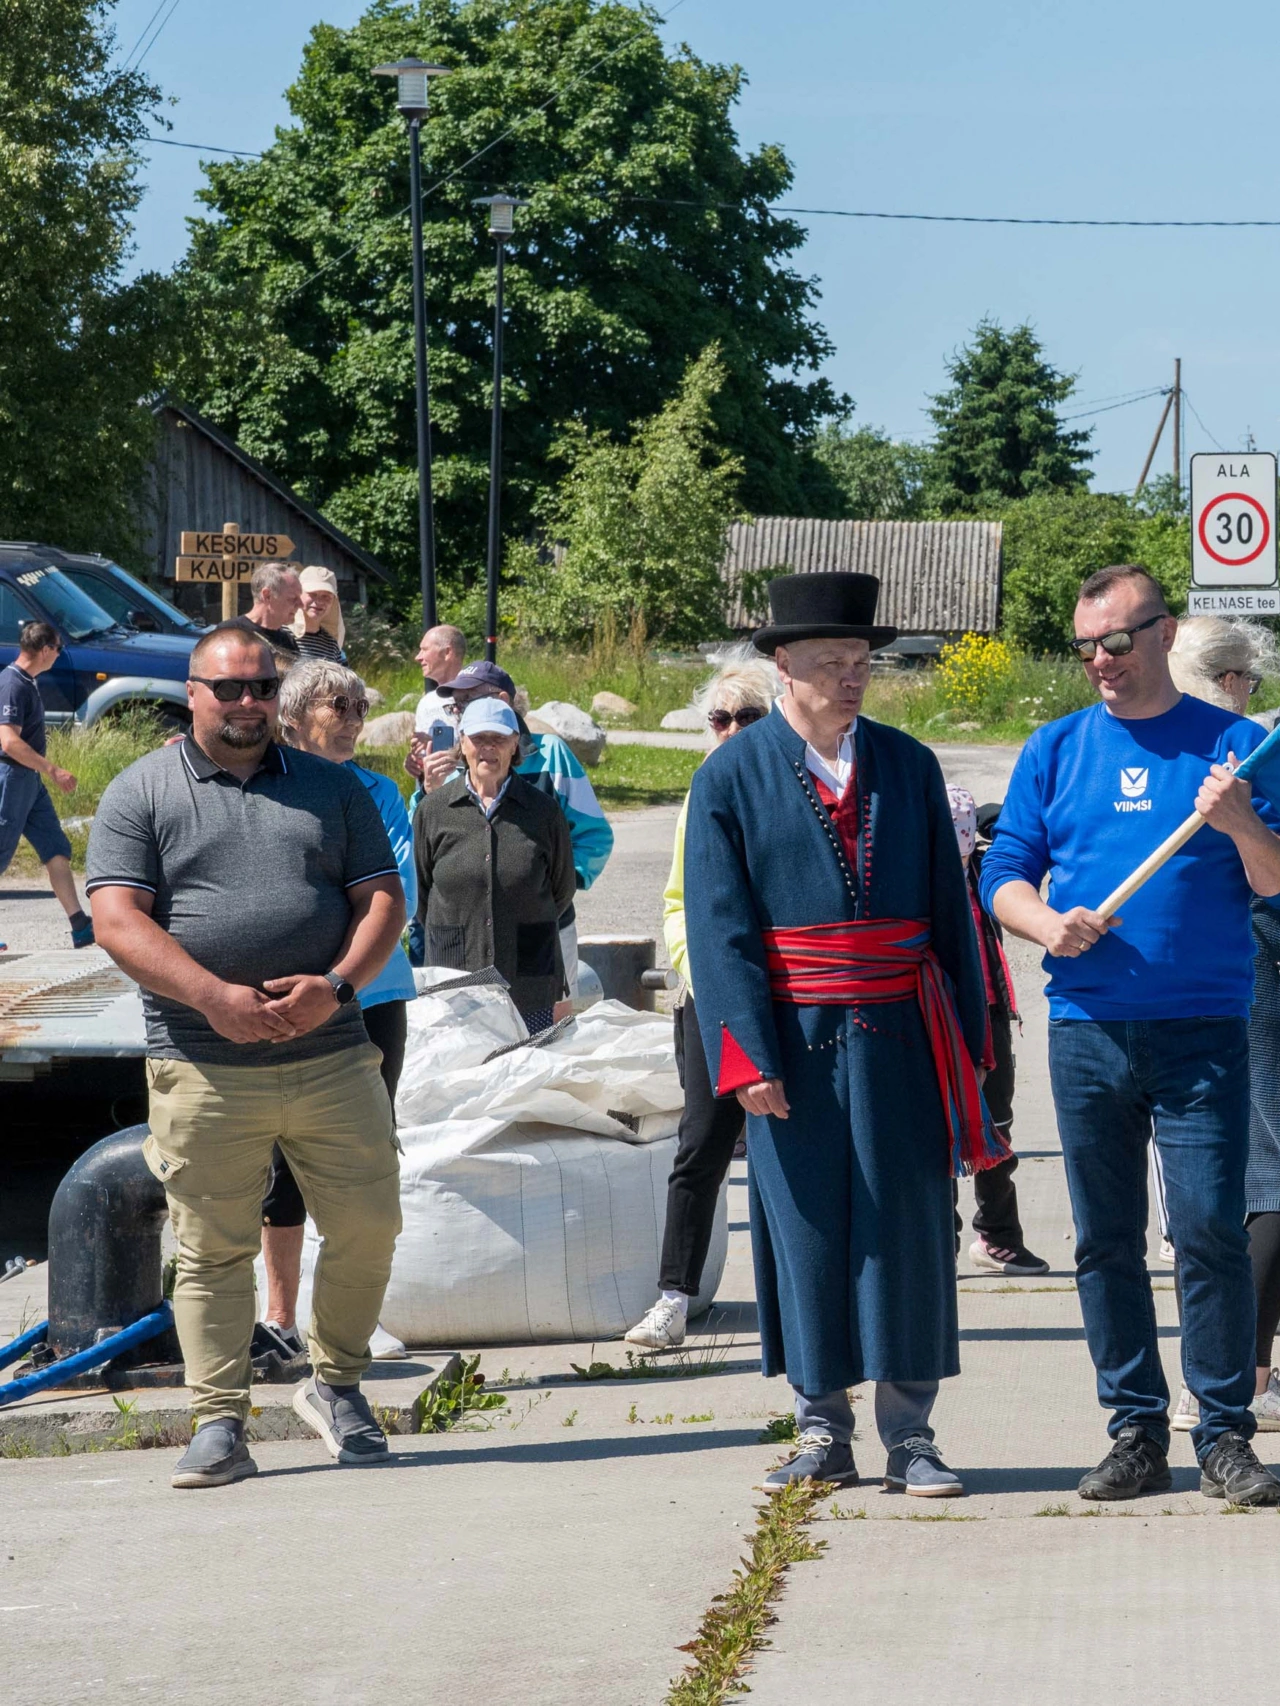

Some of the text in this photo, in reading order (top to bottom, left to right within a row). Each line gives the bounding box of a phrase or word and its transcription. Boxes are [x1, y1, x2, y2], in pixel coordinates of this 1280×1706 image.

[1217, 464, 1250, 477] ALA
[1216, 512, 1253, 544] 30
[196, 534, 278, 555] KESKUS
[1193, 597, 1275, 609] KELNASE tee
[1113, 799, 1152, 812] VIIMSI
